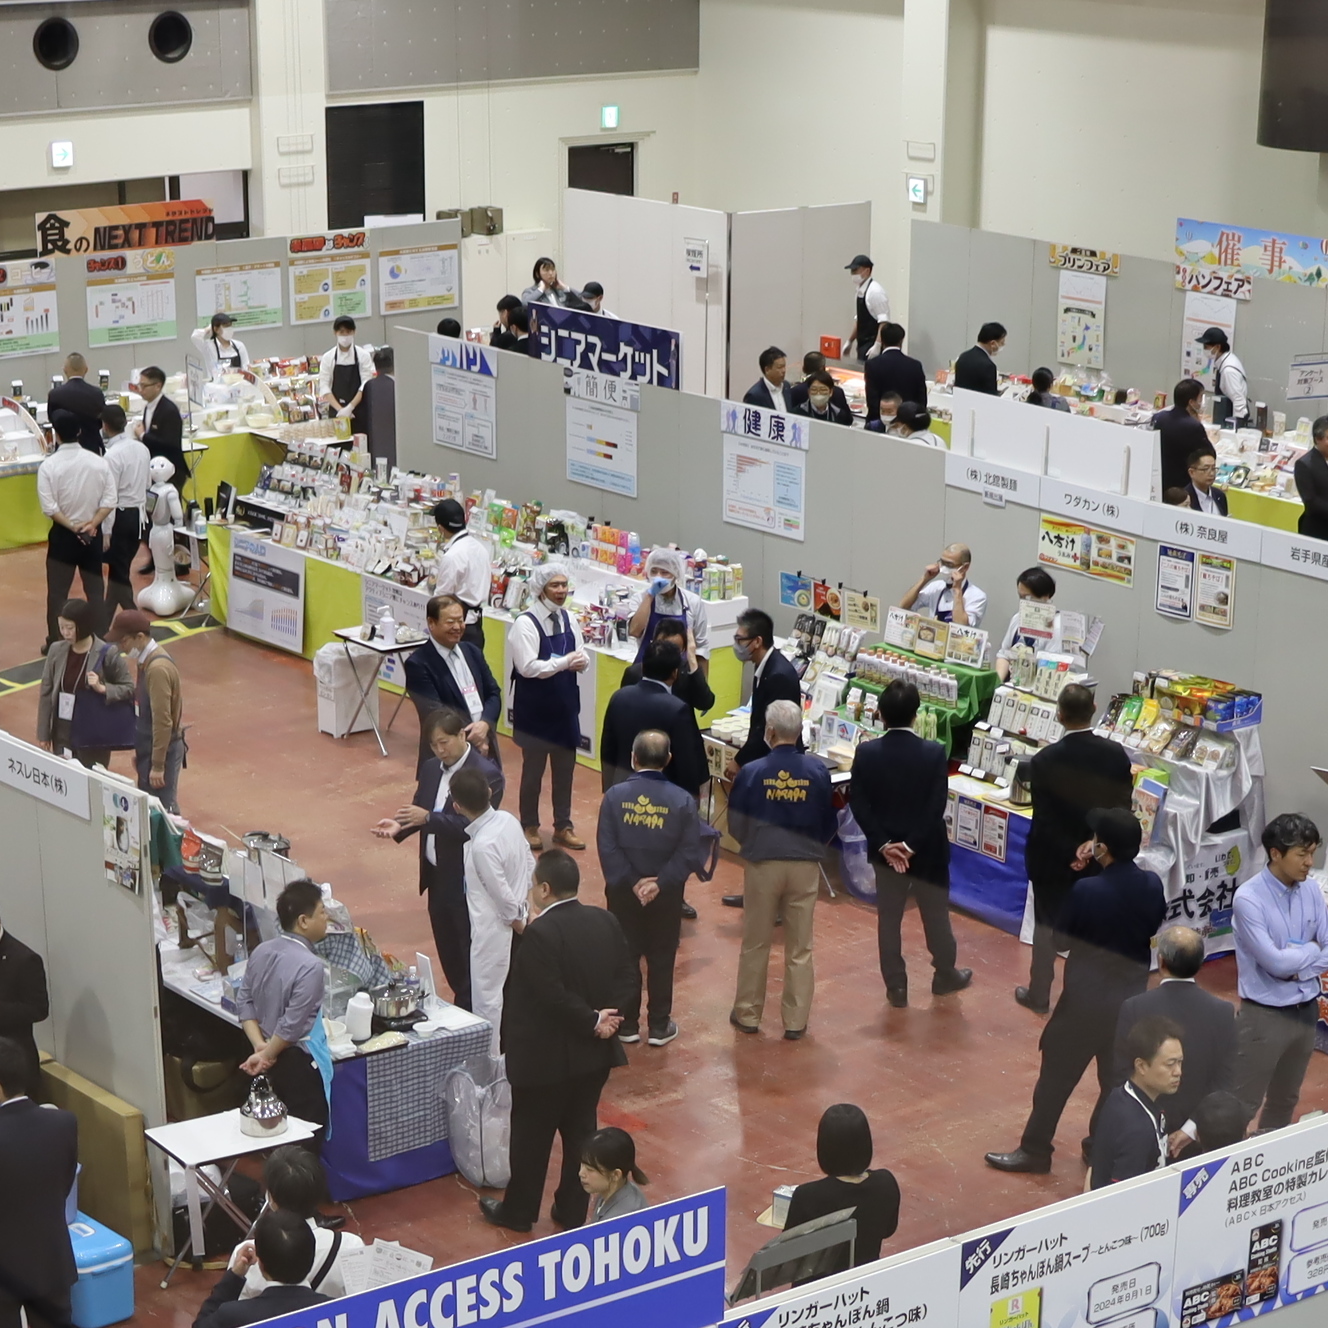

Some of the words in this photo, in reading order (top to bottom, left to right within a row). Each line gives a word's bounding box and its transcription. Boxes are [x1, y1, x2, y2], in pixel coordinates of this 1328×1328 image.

[93, 223, 147, 251] NEXT
[152, 215, 215, 246] TREND
[133, 251, 171, 272] うどん
[1057, 253, 1112, 274] プリンフェア
[1215, 230, 1289, 275] 催事
[1188, 274, 1246, 297] パンフェア
[539, 324, 670, 388] シニアマーケット
[585, 373, 618, 403] 簡便
[742, 407, 787, 443] 健康
[1064, 493, 1120, 519] ワダカン(株)
[1042, 530, 1076, 552] 八方汁
[1175, 520, 1228, 545] (株)奈良屋
[7, 756, 68, 797] ネスレ日本(株)
[1165, 877, 1241, 920] 式会社
[1230, 1152, 1265, 1176] ABC
[1228, 1174, 1258, 1195] ABC
[1259, 1191, 1307, 1217] 日本アクセス)
[1140, 1218, 1170, 1243] (700g)
[538, 1204, 710, 1300] TOHOKU
[964, 1238, 993, 1275] 先行
[992, 1232, 1068, 1269] リンガーハット
[1251, 1234, 1279, 1254] ABC
[1093, 1284, 1153, 1314] 2024年8月1日
[1111, 1277, 1137, 1295] 発売日
[778, 1285, 870, 1328] リンガーハット
[1183, 1290, 1210, 1310] ABC
